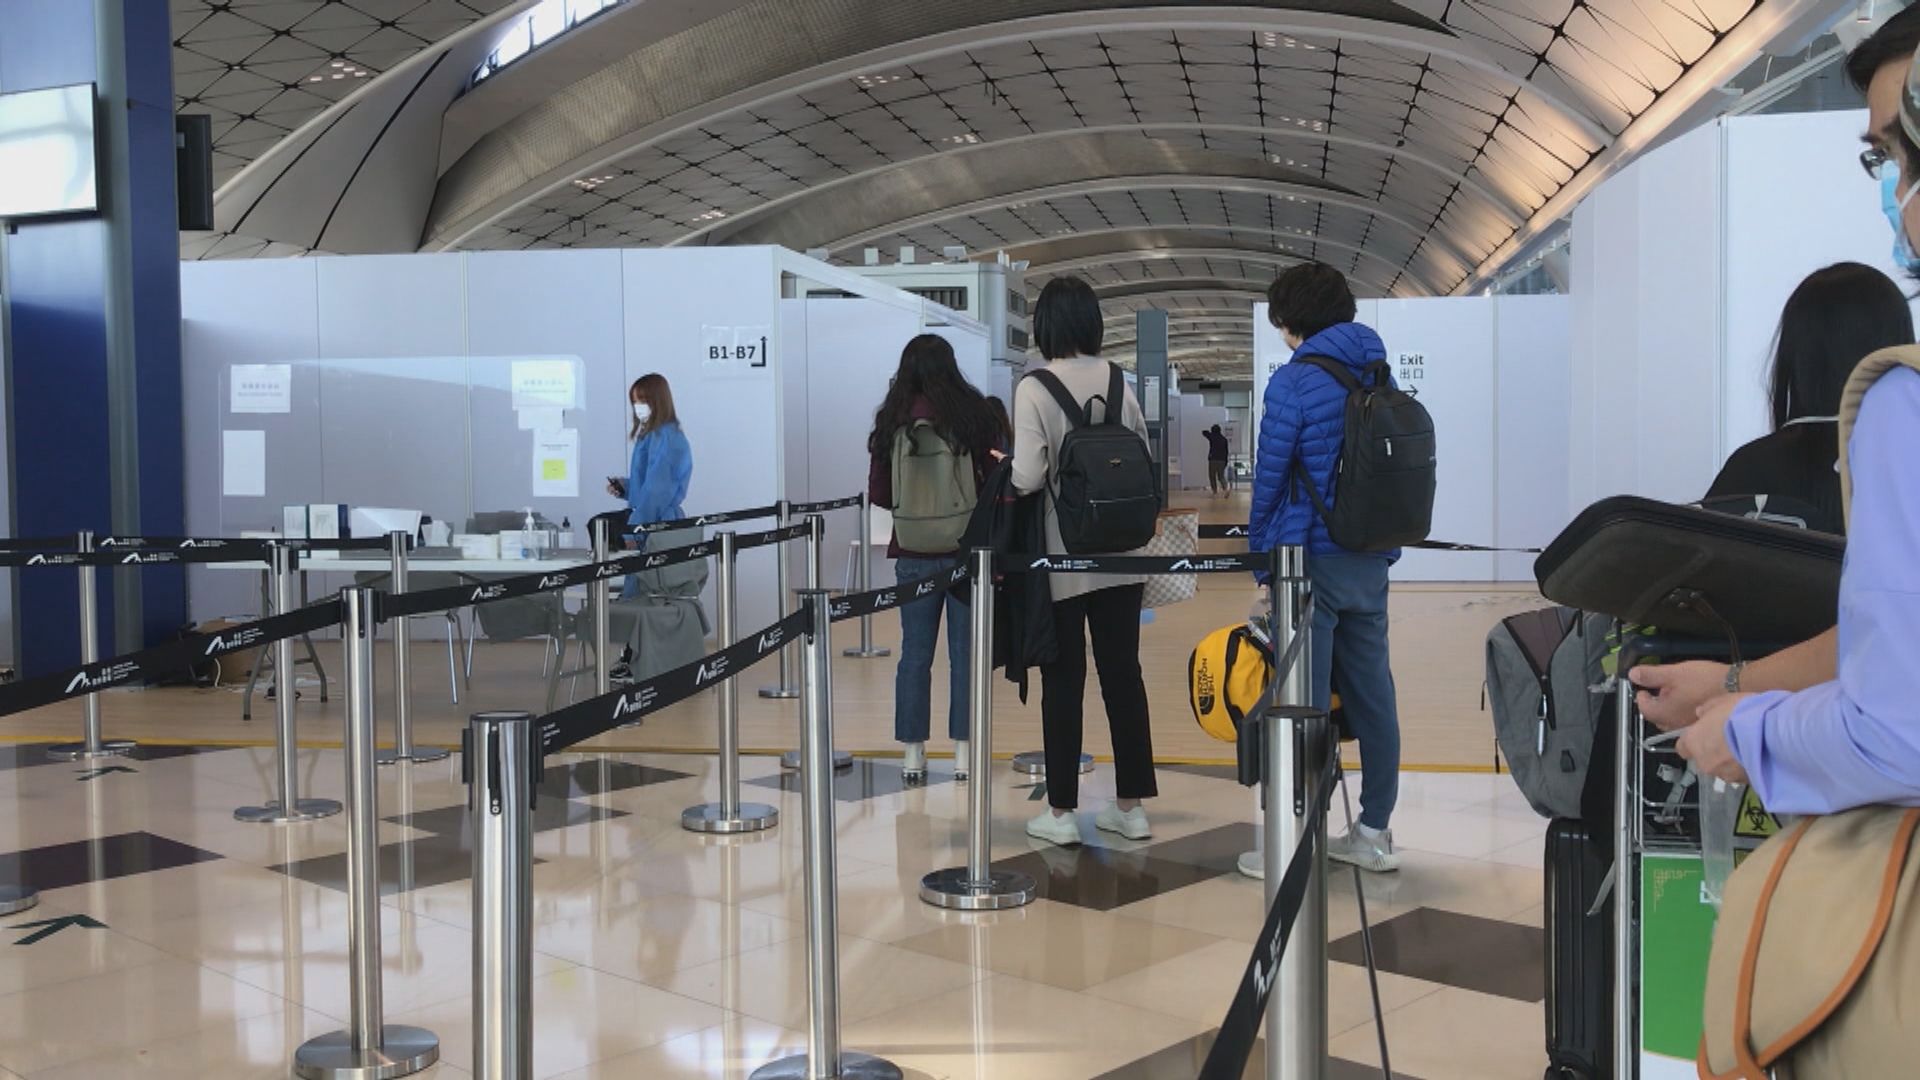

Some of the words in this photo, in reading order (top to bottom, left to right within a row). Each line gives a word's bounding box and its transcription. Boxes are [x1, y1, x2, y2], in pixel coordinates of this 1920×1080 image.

[709, 345, 756, 360] B1-B7
[1400, 354, 1424, 365] Exit
[1399, 367, 1424, 379] 出口
